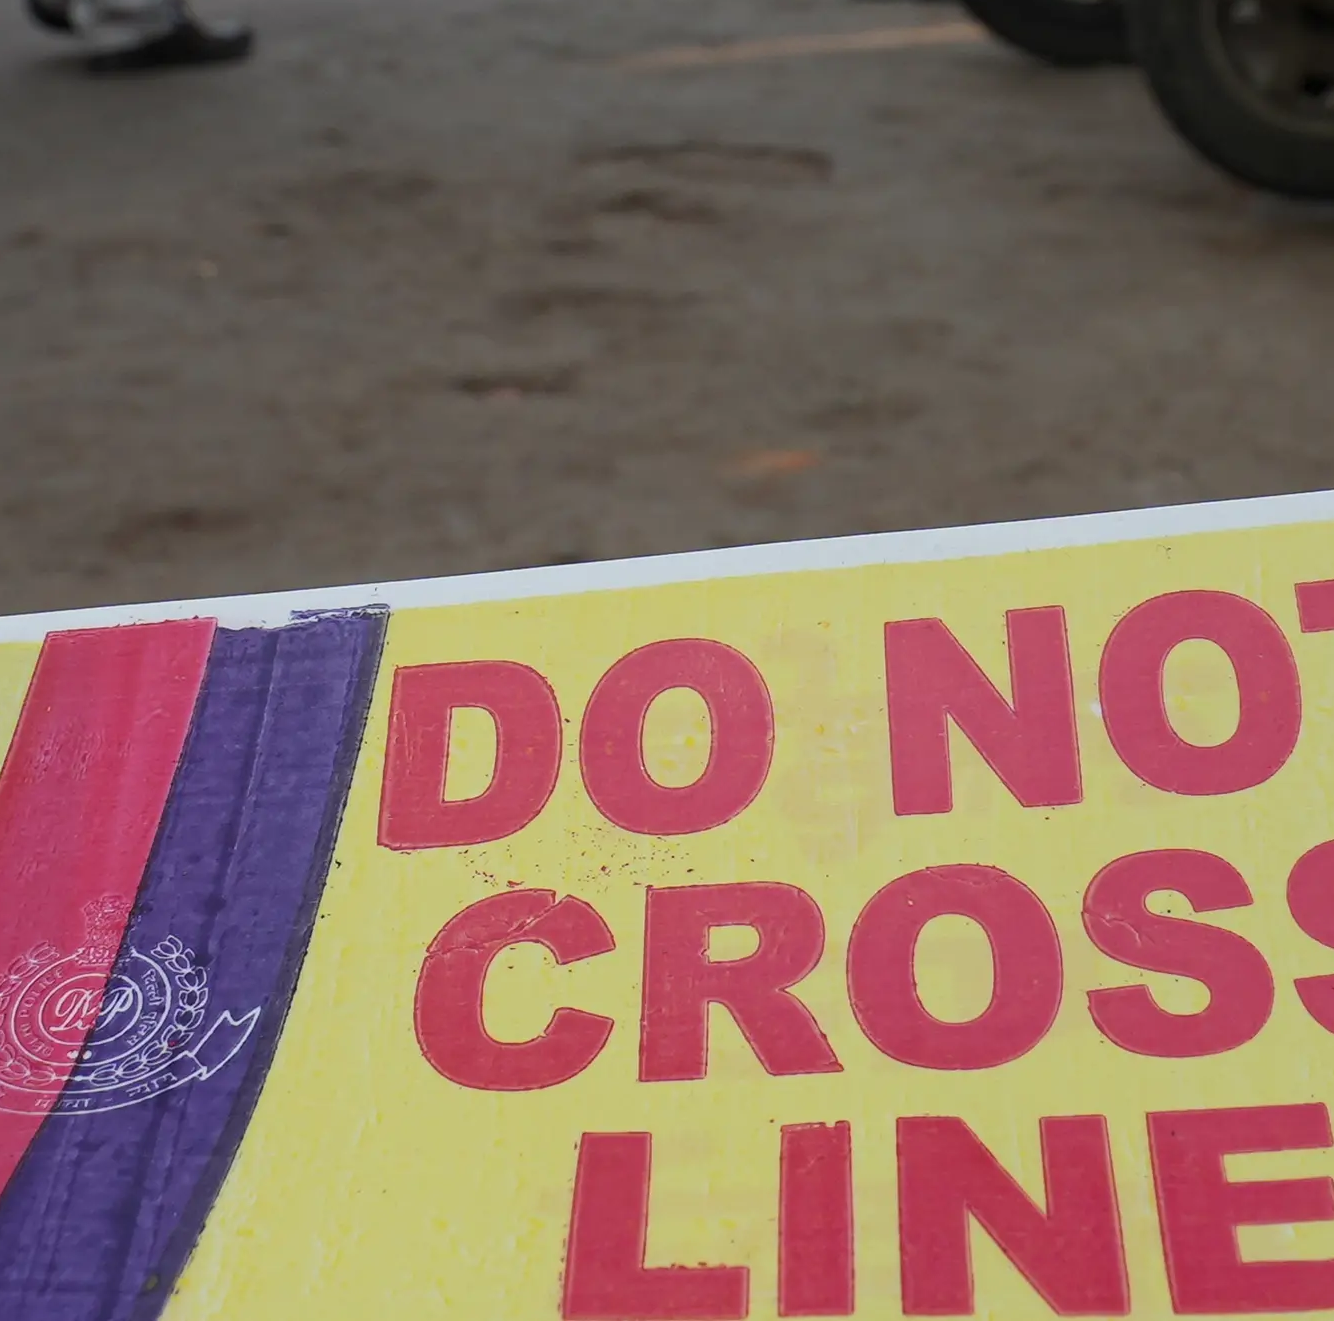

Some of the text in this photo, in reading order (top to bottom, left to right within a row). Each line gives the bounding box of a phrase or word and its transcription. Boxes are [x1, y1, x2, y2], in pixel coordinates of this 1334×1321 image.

[376, 637, 775, 851] DO
[18, 965, 64, 1057] DELHI POLICE
